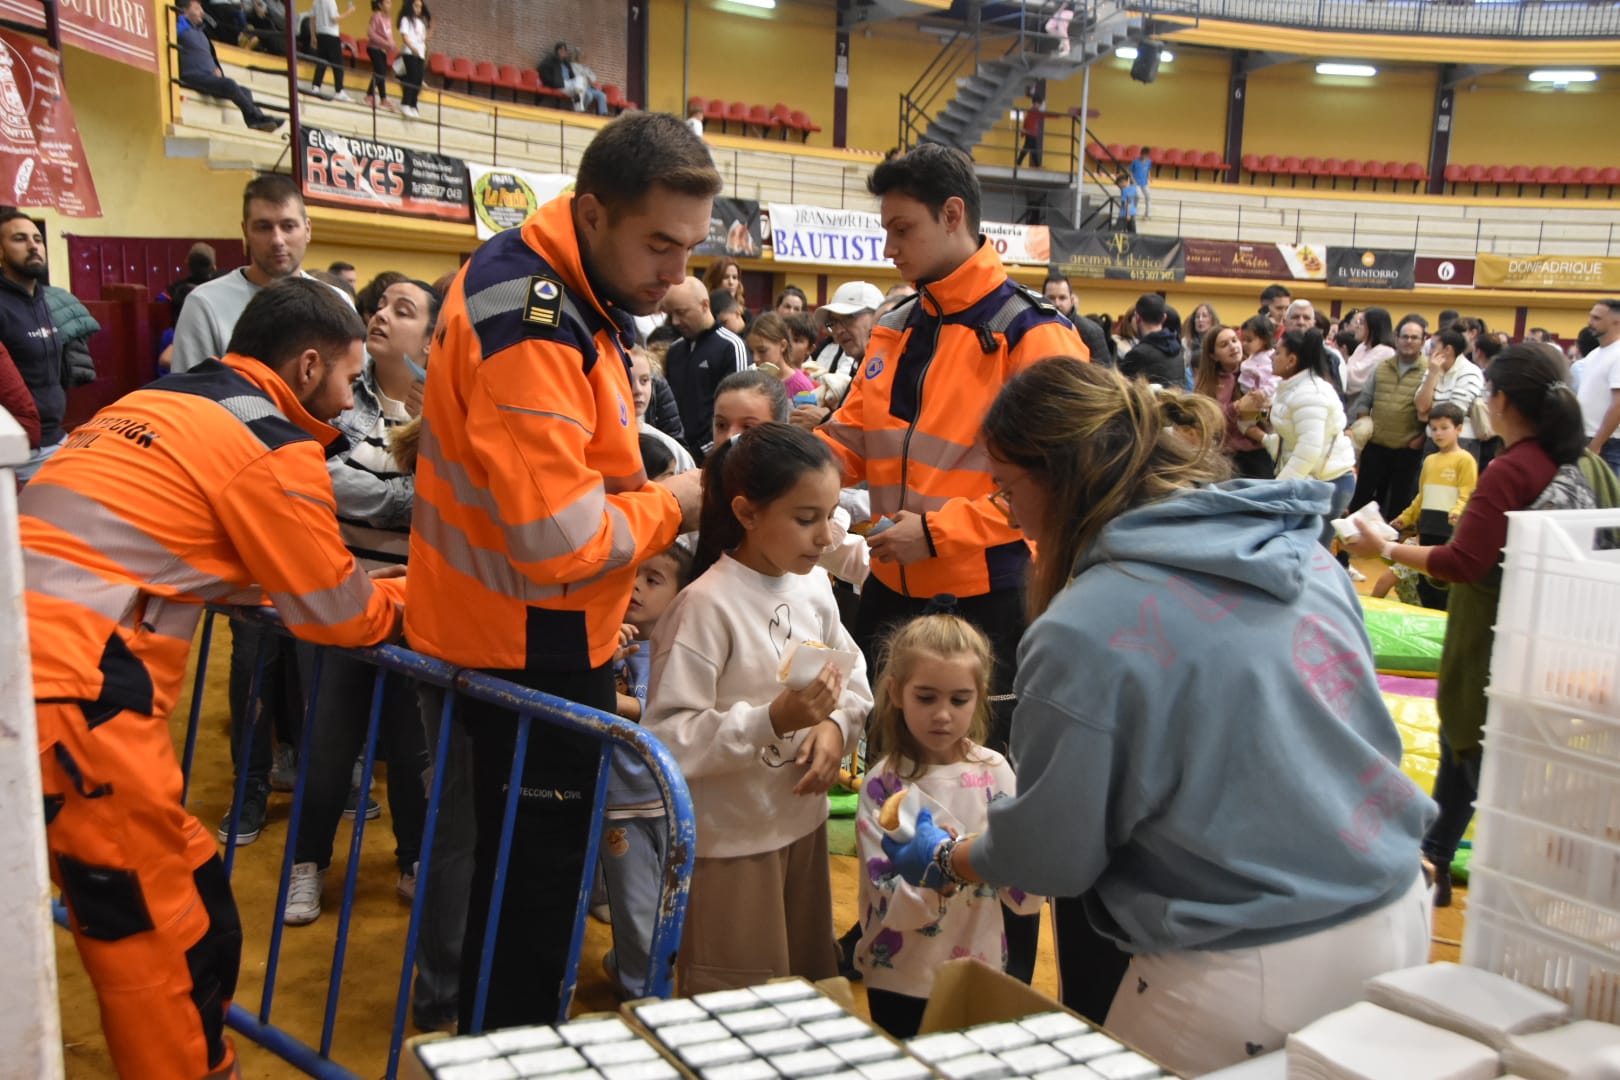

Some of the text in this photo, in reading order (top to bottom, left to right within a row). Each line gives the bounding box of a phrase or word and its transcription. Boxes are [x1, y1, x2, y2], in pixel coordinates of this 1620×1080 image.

[306, 146, 405, 197] REYES
[774, 229, 888, 262] BAUTIST
[1350, 267, 1399, 279] VENTORRO
[503, 784, 553, 798] PTECCION
